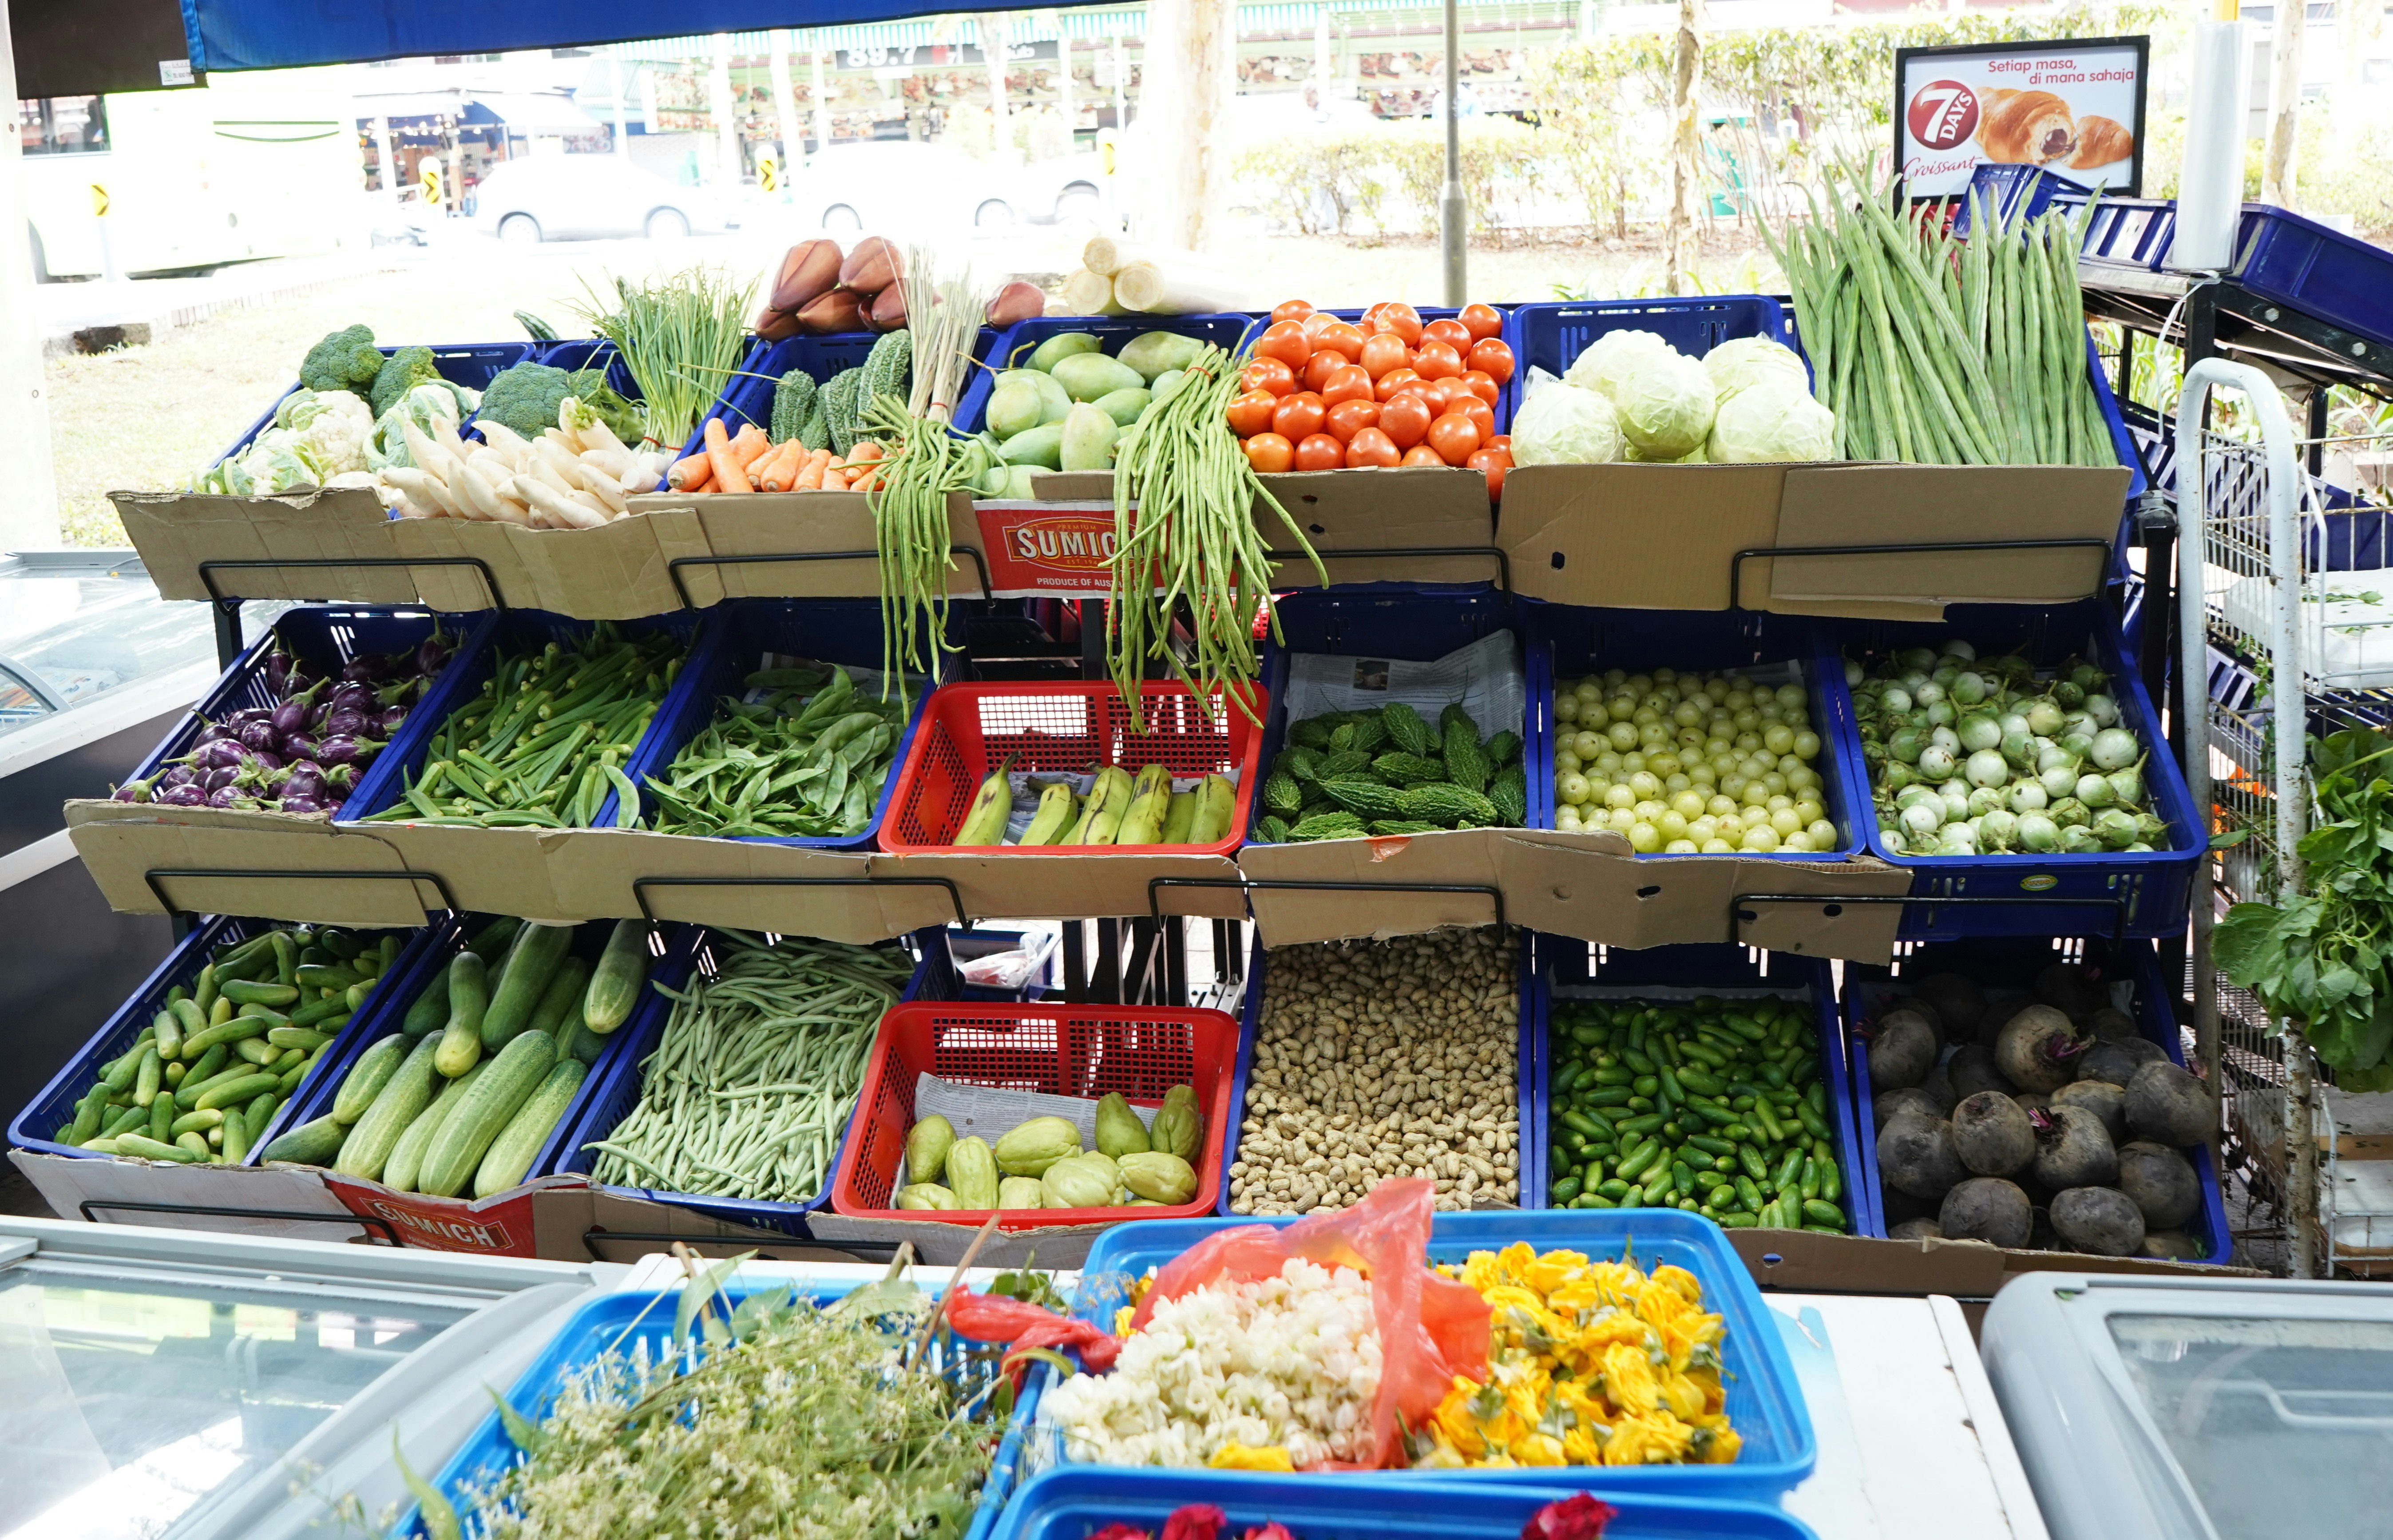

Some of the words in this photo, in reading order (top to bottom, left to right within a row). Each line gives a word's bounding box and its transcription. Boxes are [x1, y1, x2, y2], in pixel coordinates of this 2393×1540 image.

[1989, 59, 2031, 74] Setiap
[2036, 60, 2077, 70] masa,
[2029, 72, 2041, 84] di
[2046, 73, 2085, 83] mana
[2089, 68, 2134, 83] sahaja
[1920, 88, 1961, 143] 7
[1940, 92, 1973, 141] DAYS
[1902, 155, 1982, 182] Croissant
[1036, 578, 1078, 586] PRODUCE
[374, 1202, 498, 1247] SUMICH
